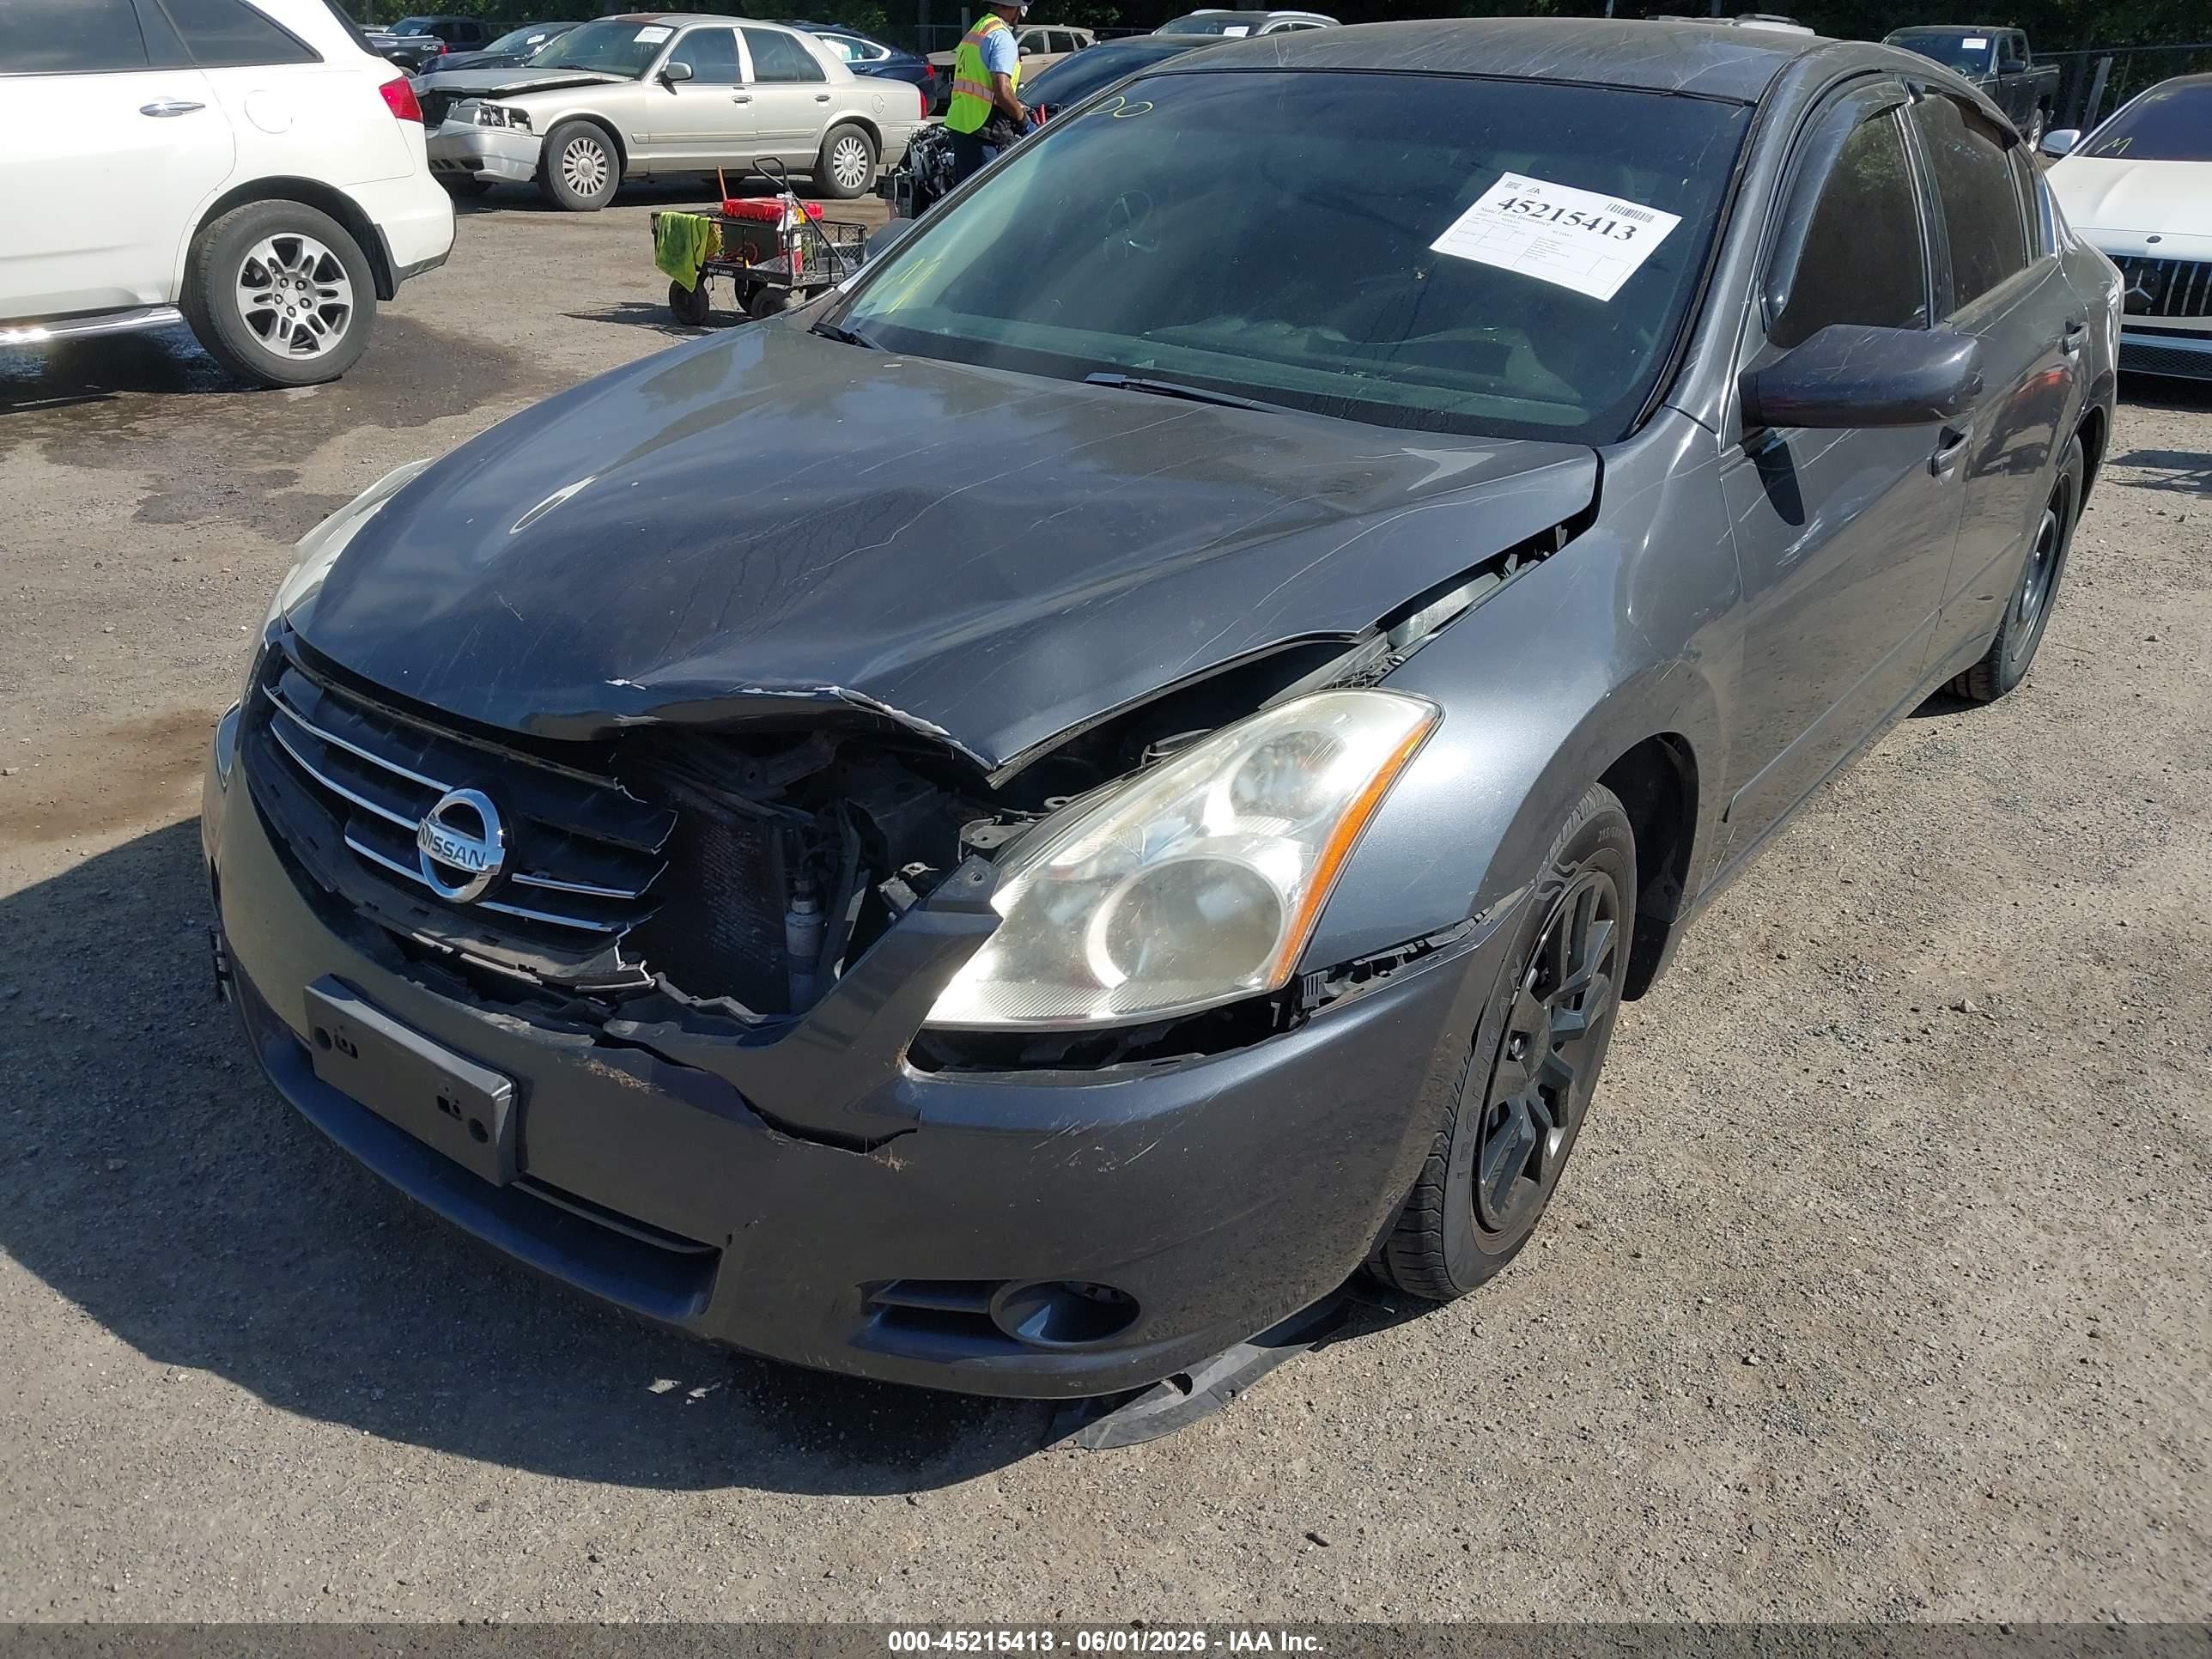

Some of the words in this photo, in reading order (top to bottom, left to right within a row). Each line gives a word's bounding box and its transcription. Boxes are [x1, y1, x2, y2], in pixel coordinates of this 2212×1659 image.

[1480, 206, 1498, 215] State
[1498, 209, 1517, 220] Farm
[1517, 214, 1552, 228] Insurance
[1497, 197, 1638, 241] 45215413
[418, 825, 487, 867] NISSAN
